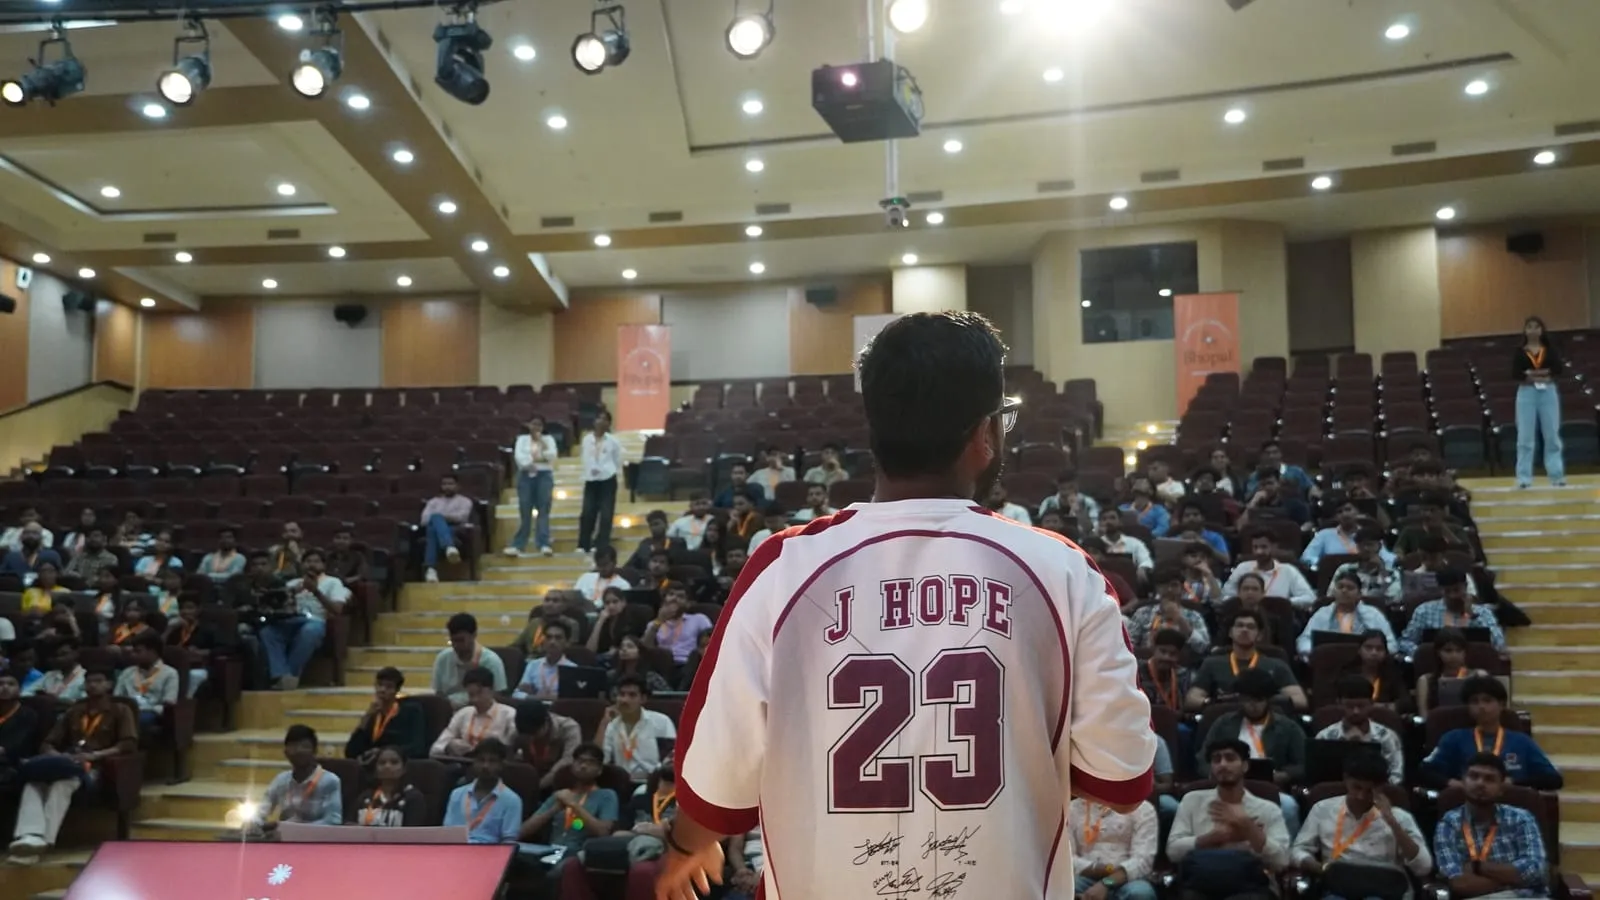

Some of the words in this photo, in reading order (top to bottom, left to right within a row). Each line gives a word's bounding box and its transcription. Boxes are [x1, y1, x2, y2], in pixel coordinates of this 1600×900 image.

[824, 586, 854, 645] J
[880, 574, 1012, 640] HOPE
[827, 646, 1005, 813] 23
